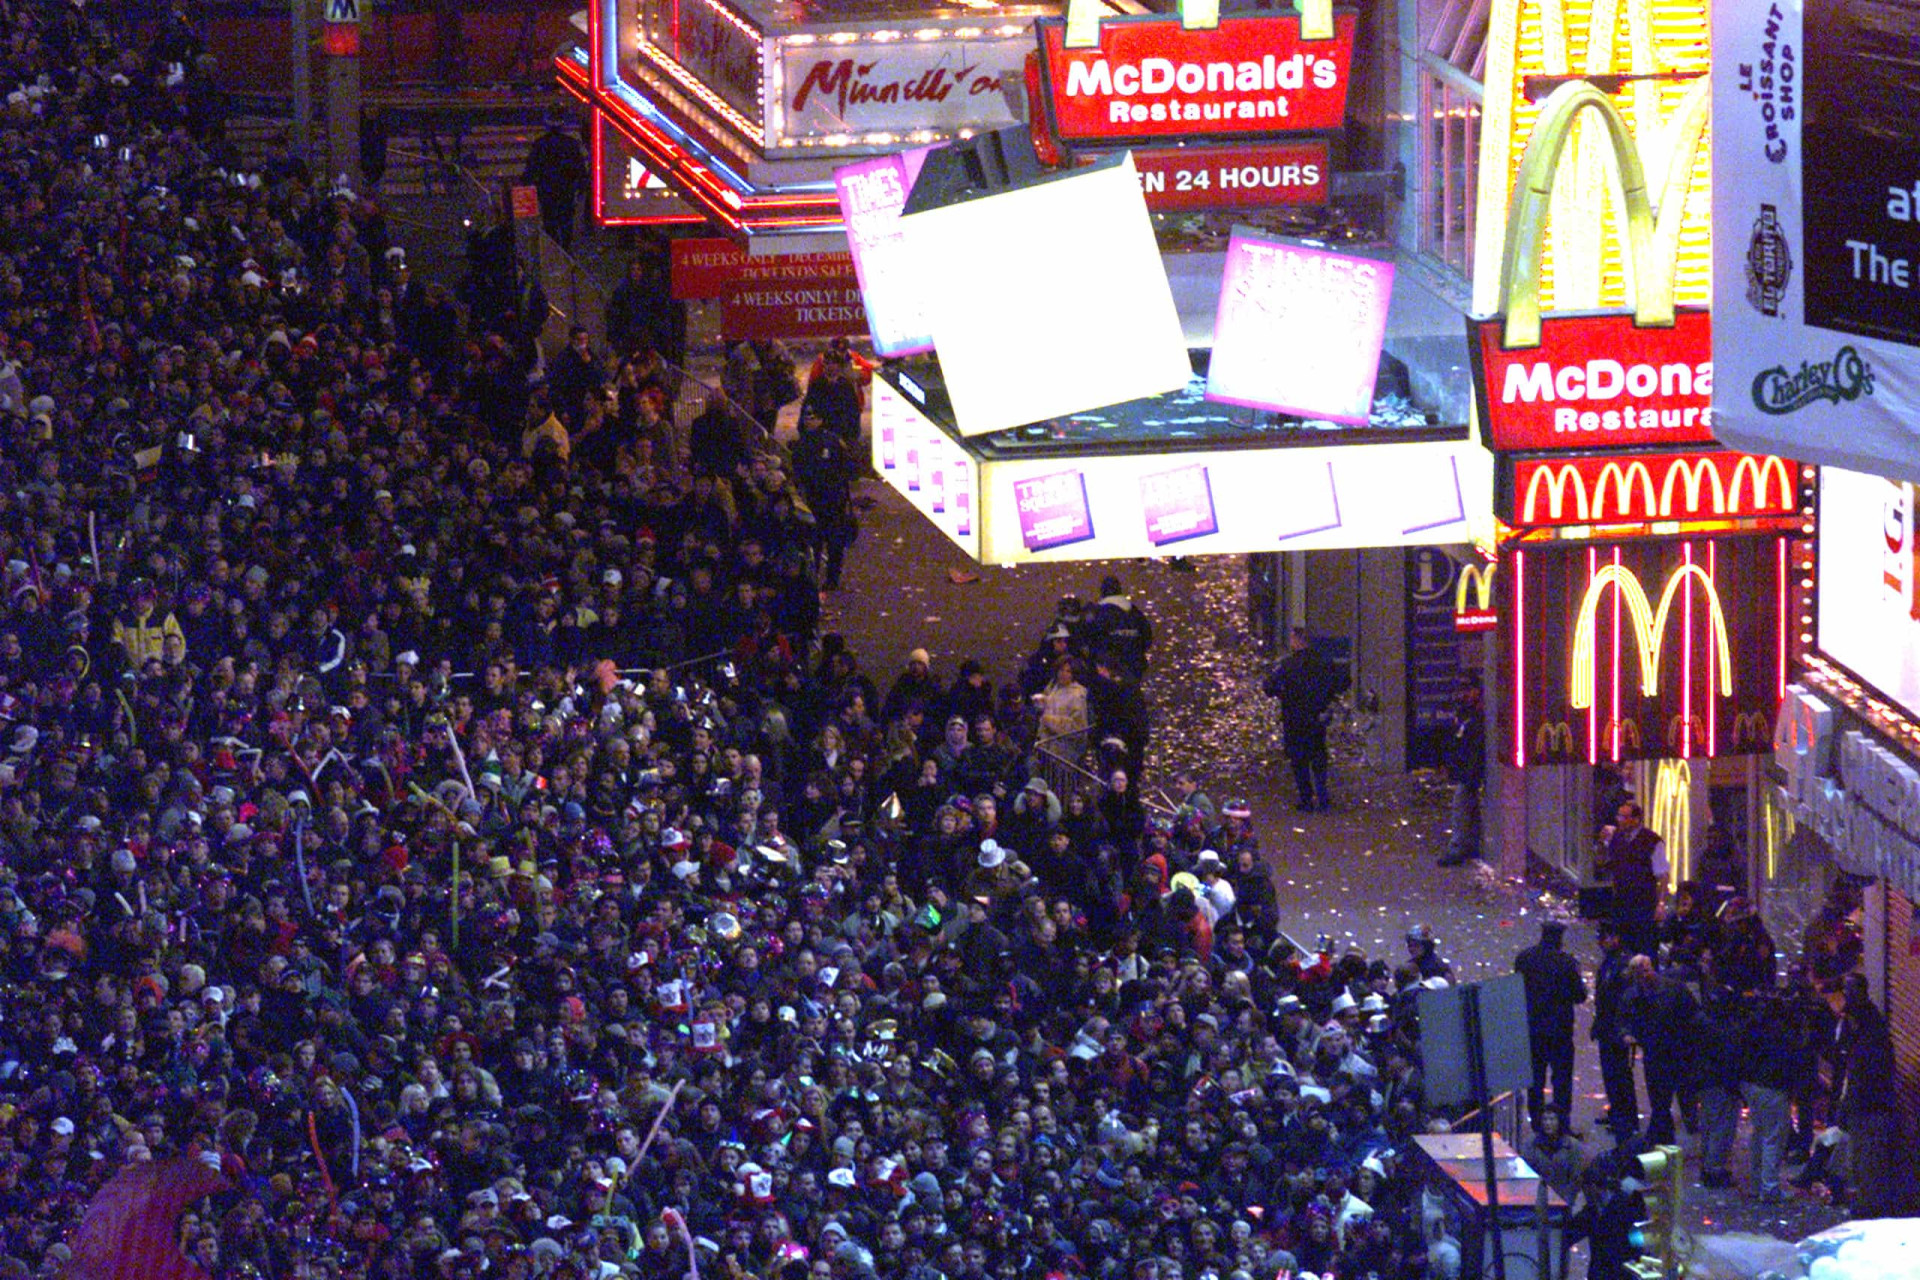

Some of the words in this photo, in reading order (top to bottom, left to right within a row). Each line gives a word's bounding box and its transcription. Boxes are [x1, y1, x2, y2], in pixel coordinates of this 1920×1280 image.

[1066, 54, 1337, 96] McDonald's
[1740, 63, 1752, 91] LE
[1780, 44, 1795, 121] SHOP
[1109, 96, 1289, 123] Restaurant
[1175, 170, 1210, 191] 24
[1220, 164, 1320, 189] HOURS
[681, 253, 689, 266] 4
[692, 252, 739, 266] WEEKS
[1845, 239, 1910, 289] The
[733, 292, 741, 306] 4
[744, 291, 793, 306] WEEKS
[796, 307, 853, 322] TICKETS
